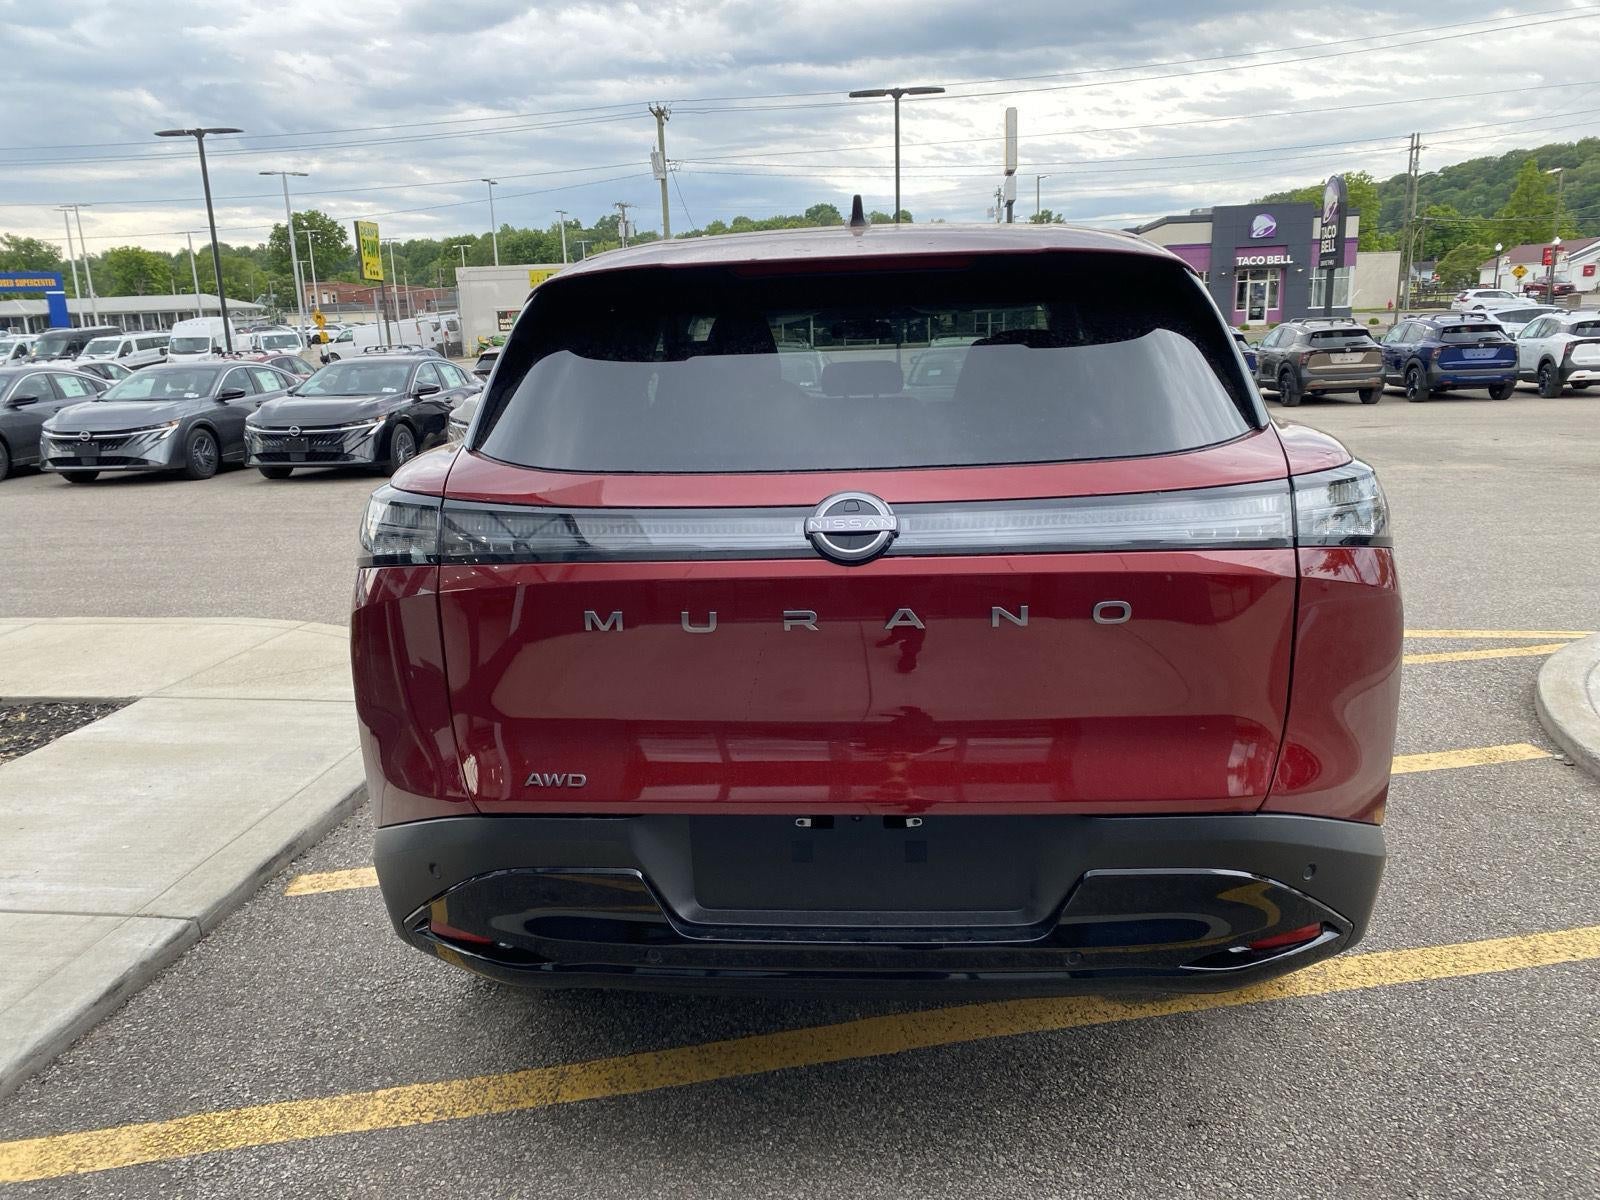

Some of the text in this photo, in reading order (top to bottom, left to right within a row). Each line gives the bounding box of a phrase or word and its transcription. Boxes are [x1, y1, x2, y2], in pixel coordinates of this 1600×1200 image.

[1321, 225, 1336, 239] TACO
[1320, 239, 1336, 253] BELL
[1236, 255, 1293, 265] TACO BELL
[809, 516, 895, 530] NISSAN
[584, 600, 1132, 633] MURANO
[524, 772, 587, 787] AWD
